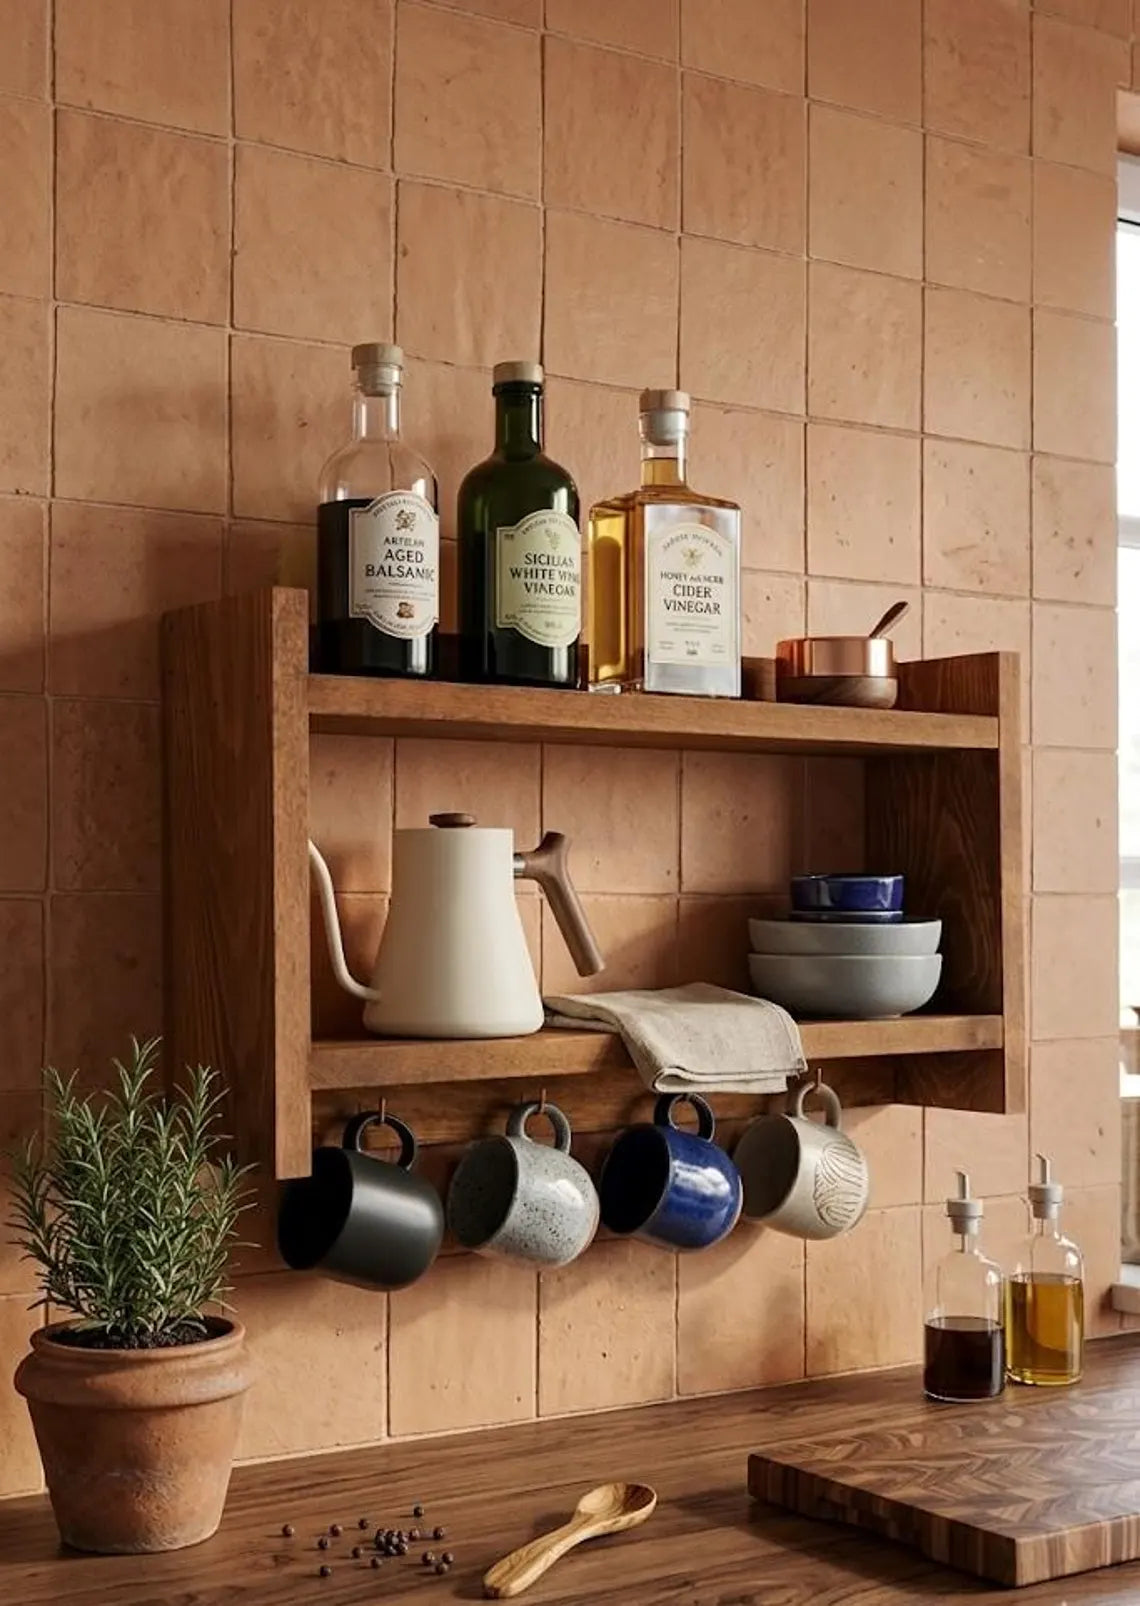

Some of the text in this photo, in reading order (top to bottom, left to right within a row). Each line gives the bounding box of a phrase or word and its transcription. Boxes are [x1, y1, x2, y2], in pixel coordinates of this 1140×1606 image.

[384, 548, 424, 563] AGED
[509, 567, 556, 580] WHITE
[673, 584, 712, 598] CIDER
[663, 598, 721, 615] VINEGAR
